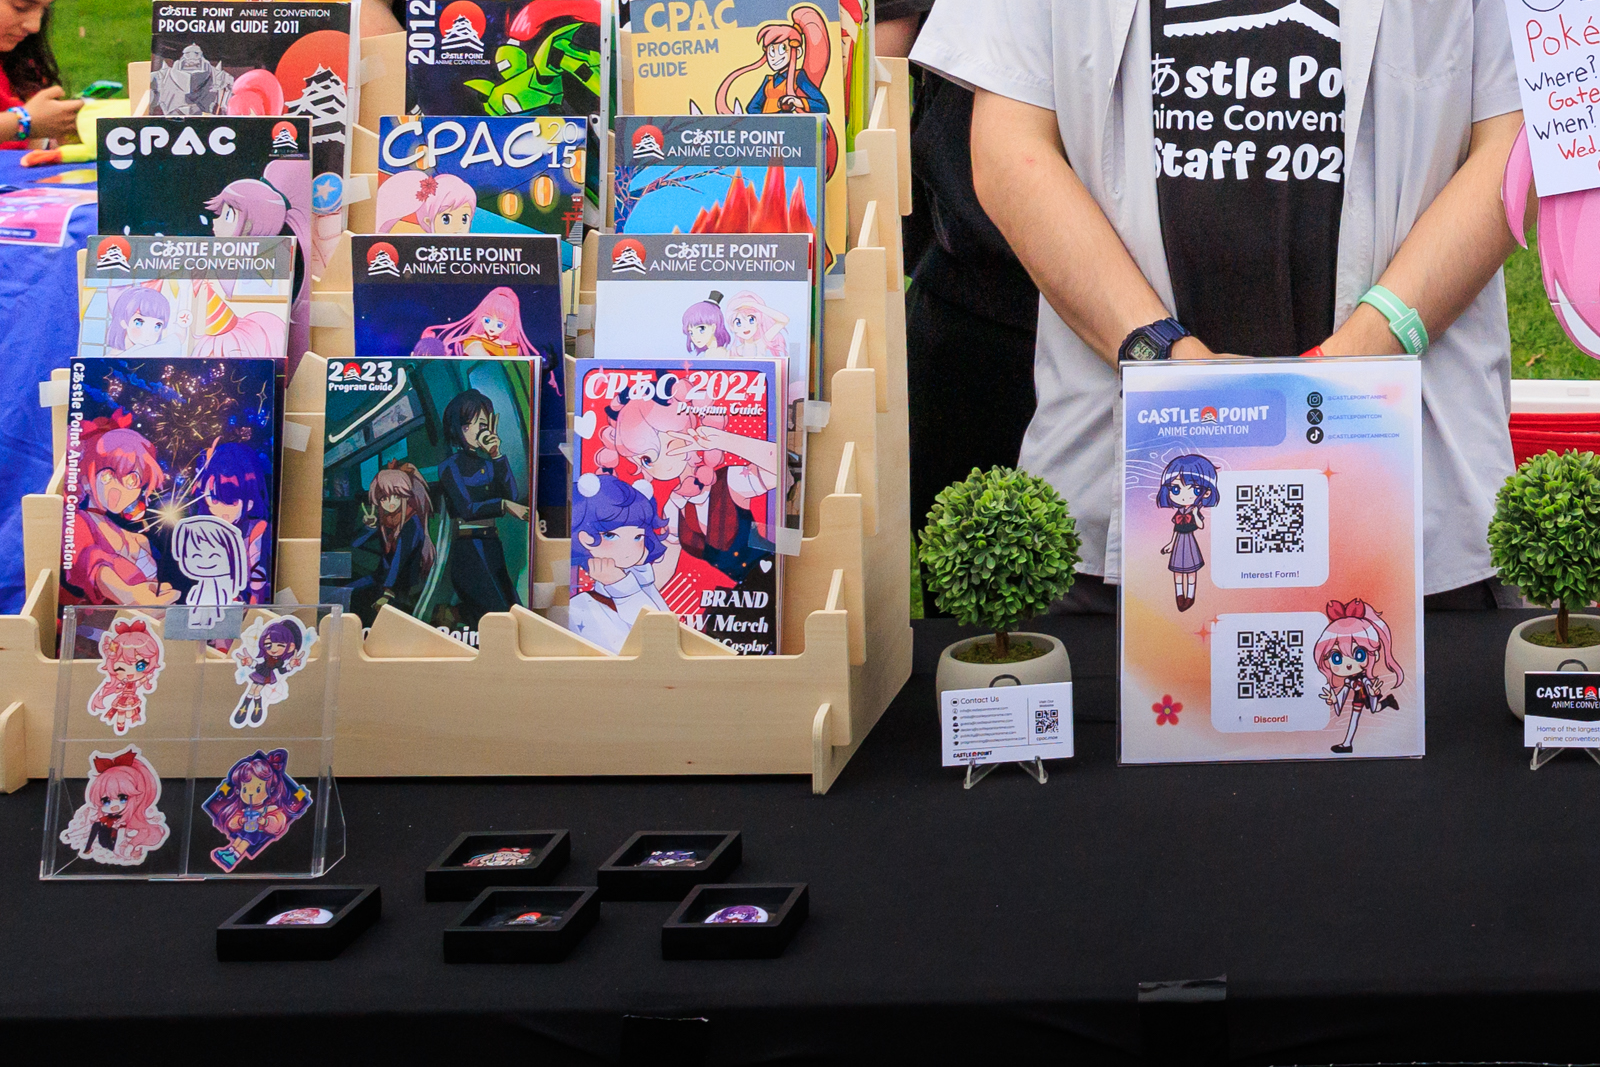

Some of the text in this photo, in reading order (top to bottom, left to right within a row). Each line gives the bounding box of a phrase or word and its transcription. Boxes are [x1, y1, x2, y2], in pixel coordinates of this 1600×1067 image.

[202, 8, 234, 17] POINT
[273, 9, 330, 17] CONVENTION
[644, 0, 738, 33] CPAC
[158, 20, 299, 33] PROGRAM GUIDE 2011
[408, 0, 436, 65] 2012
[637, 38, 720, 58] PROGRAM
[638, 61, 688, 79] GUIDE
[1525, 55, 1598, 92] Where?
[1153, 103, 1214, 131] nime
[1533, 105, 1597, 140] When?
[105, 127, 237, 156] CPAC
[382, 120, 578, 169] CPAC 20
[740, 131, 785, 145] POINT
[547, 146, 577, 168] 15
[667, 145, 802, 158] ANIME CONVENTION
[1558, 136, 1600, 160] Wed.
[1265, 142, 1345, 183] 202
[213, 242, 260, 256] POINT
[476, 247, 522, 262] POINT
[733, 244, 778, 258] POINT
[133, 258, 275, 271] ANIME CONVENTION
[403, 262, 540, 275] ANIME CONVENTION
[649, 259, 796, 272] ANIME CONVENTION
[329, 383, 392, 393] Program Guide
[687, 371, 767, 401] 2024
[676, 402, 764, 416] Program Guide
[1138, 405, 1269, 425] CASTLE POINT
[70, 412, 83, 447] Point
[1158, 425, 1249, 436] ANIME CONVENTION
[67, 449, 81, 491] Anime
[63, 497, 78, 570] Convention
[1240, 571, 1272, 579] Interest
[700, 590, 769, 608] BRAND
[713, 614, 769, 633] Merch
[1536, 686, 1583, 699] CASTLE
[1253, 715, 1288, 723] Discord!
[1578, 726, 1600, 735] largest
